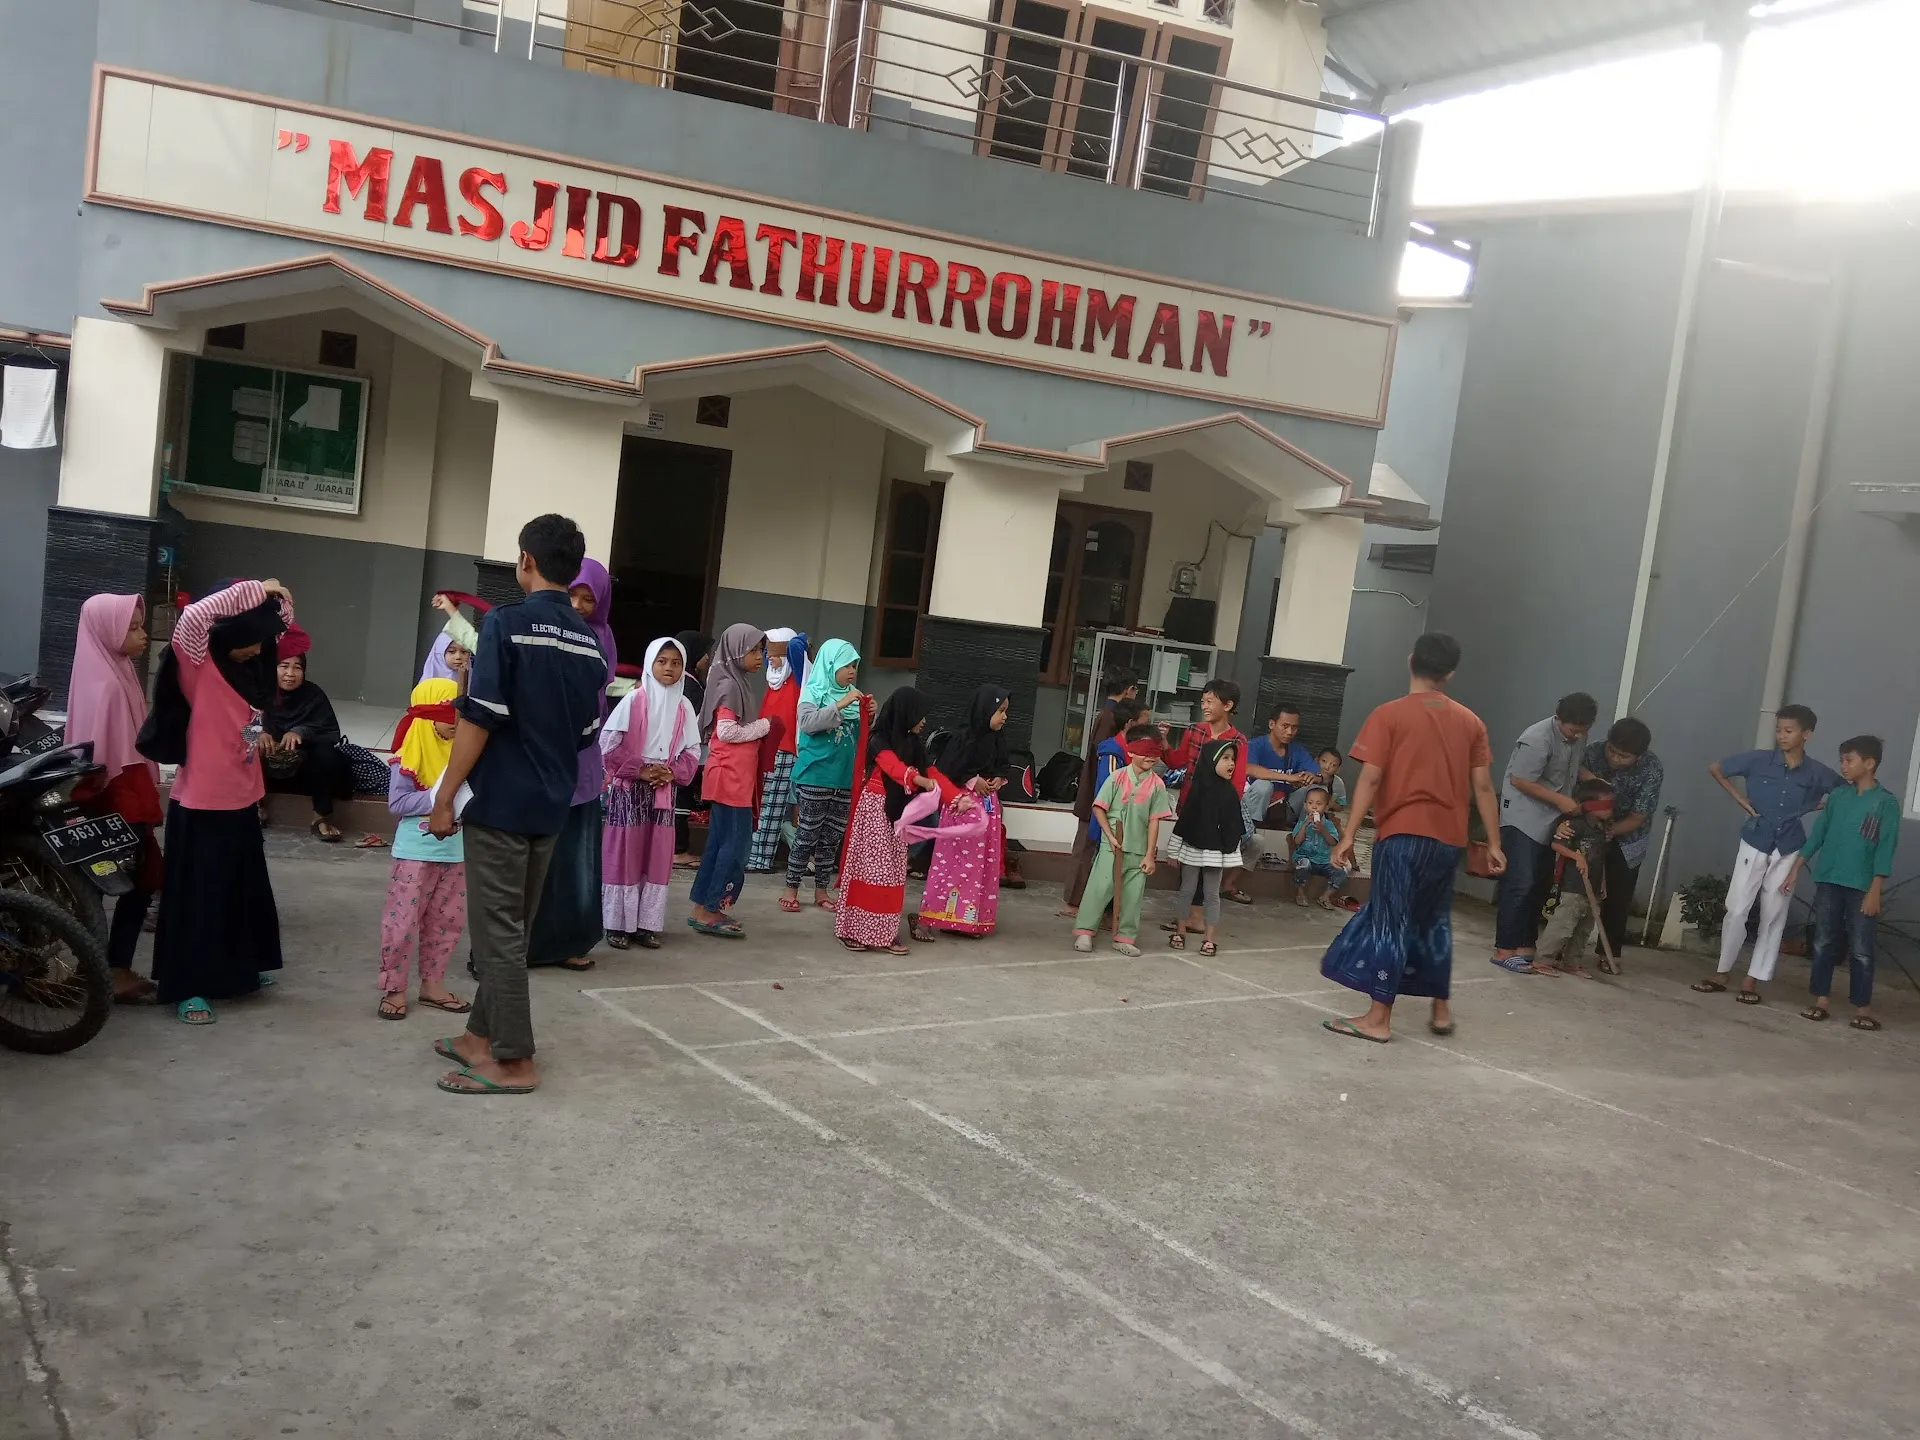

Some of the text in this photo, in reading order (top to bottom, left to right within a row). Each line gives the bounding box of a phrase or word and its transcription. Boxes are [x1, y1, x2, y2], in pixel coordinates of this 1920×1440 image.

[314, 483, 343, 495] JUARA
[37, 733, 62, 751] 3956
[50, 817, 122, 848] R 3631 EF
